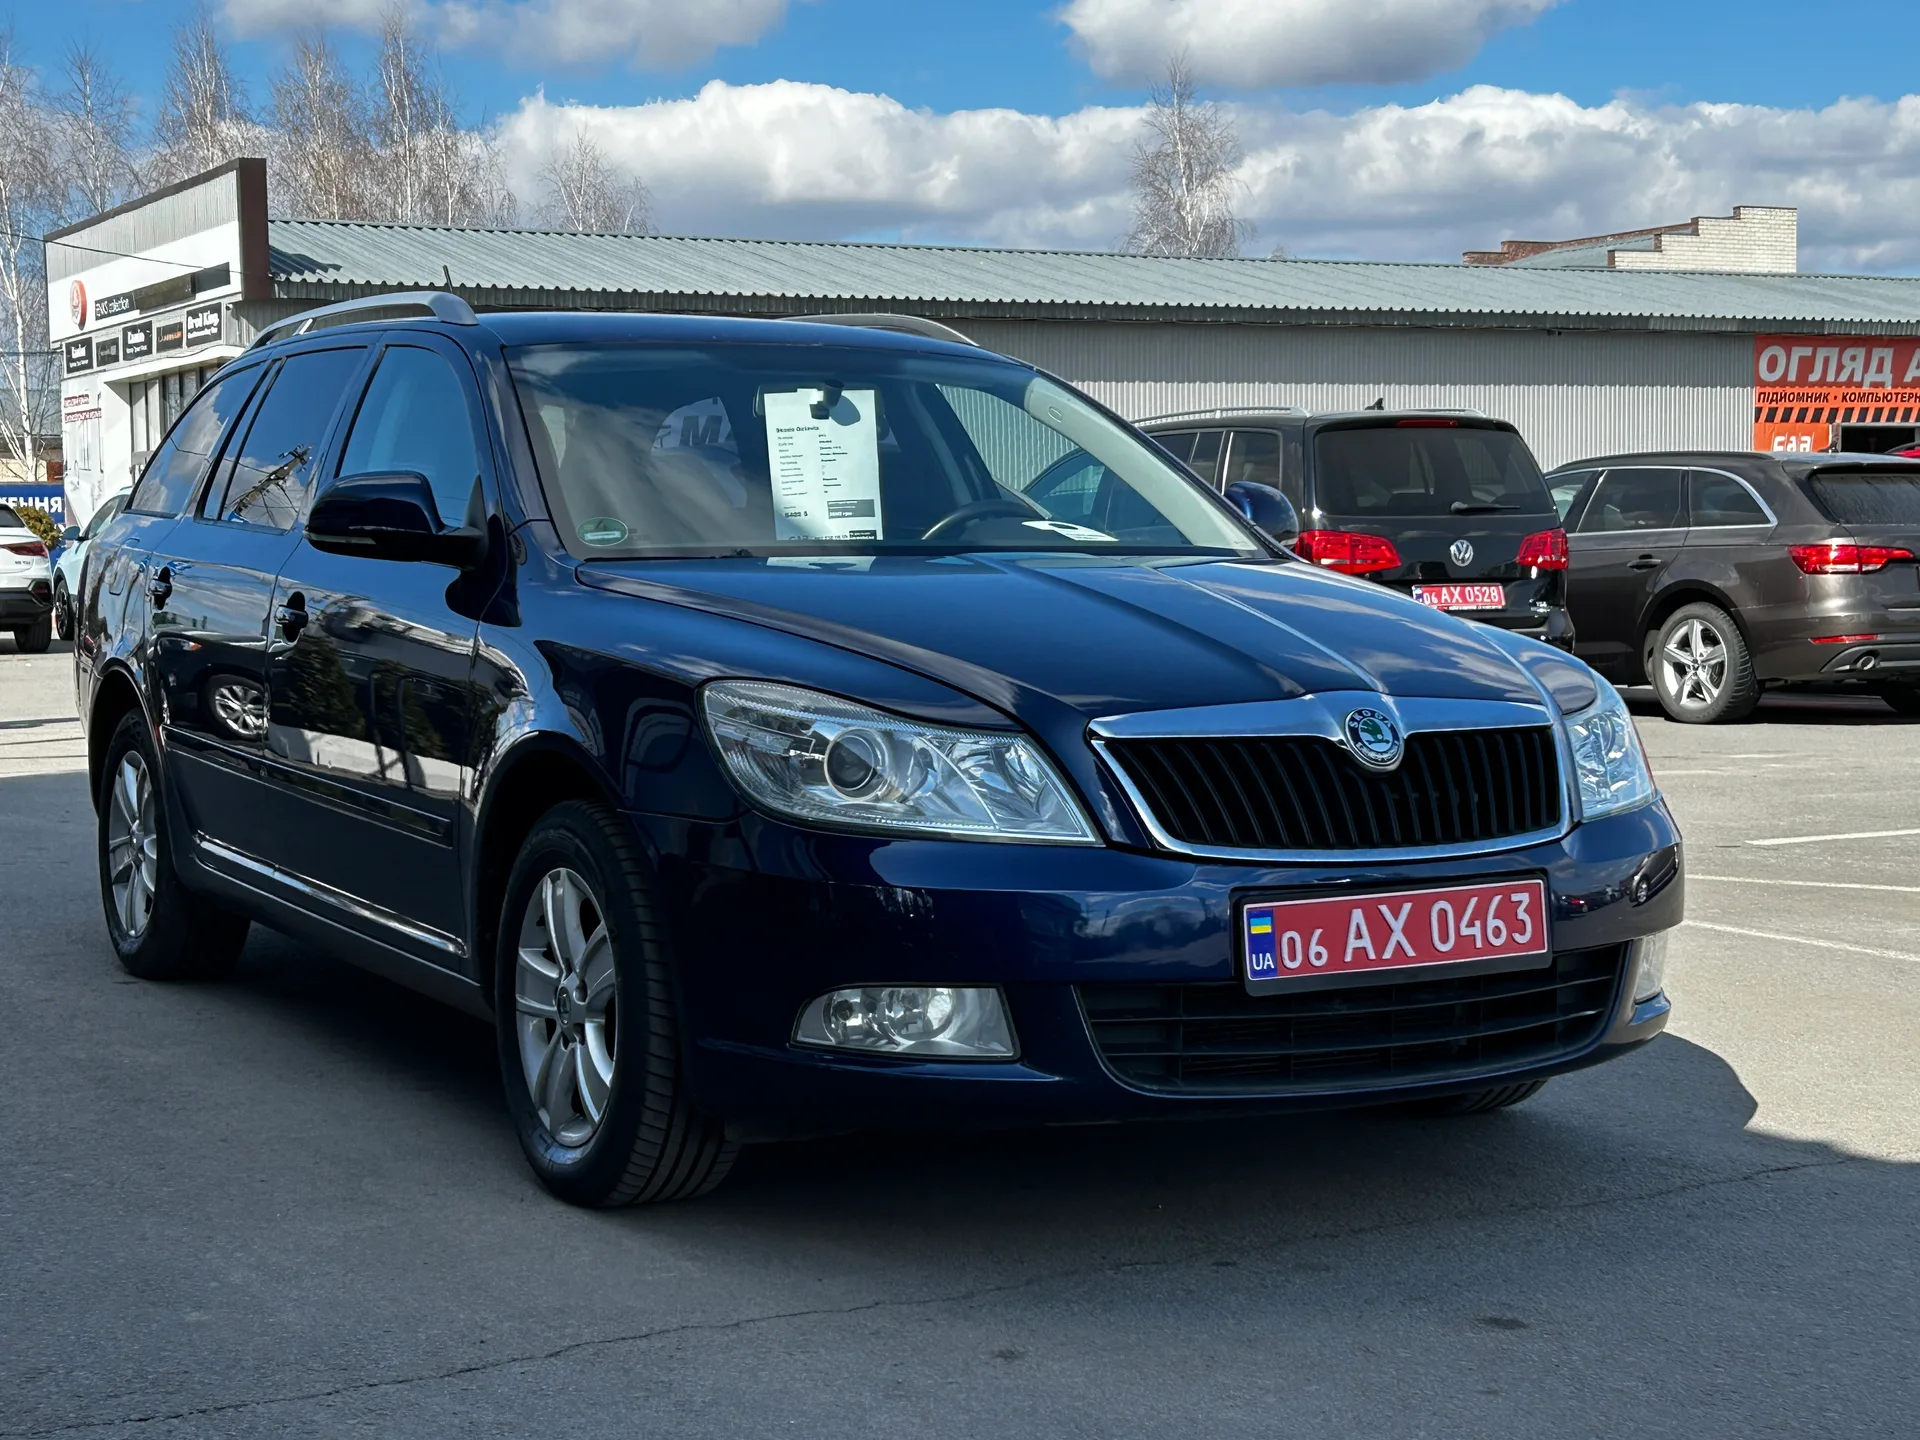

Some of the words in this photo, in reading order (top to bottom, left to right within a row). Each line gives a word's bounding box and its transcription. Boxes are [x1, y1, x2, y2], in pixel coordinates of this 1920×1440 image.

[1758, 345, 1894, 390] ОГЛЯД
[1757, 390, 1831, 405] ПІДЙОМНИК
[1423, 591, 1438, 604] 06
[1441, 587, 1462, 603] AX
[1465, 586, 1499, 603] 0528
[1281, 928, 1328, 969] 06
[1344, 902, 1416, 962] AX
[1430, 892, 1532, 952] 0463
[1252, 952, 1275, 970] UA
